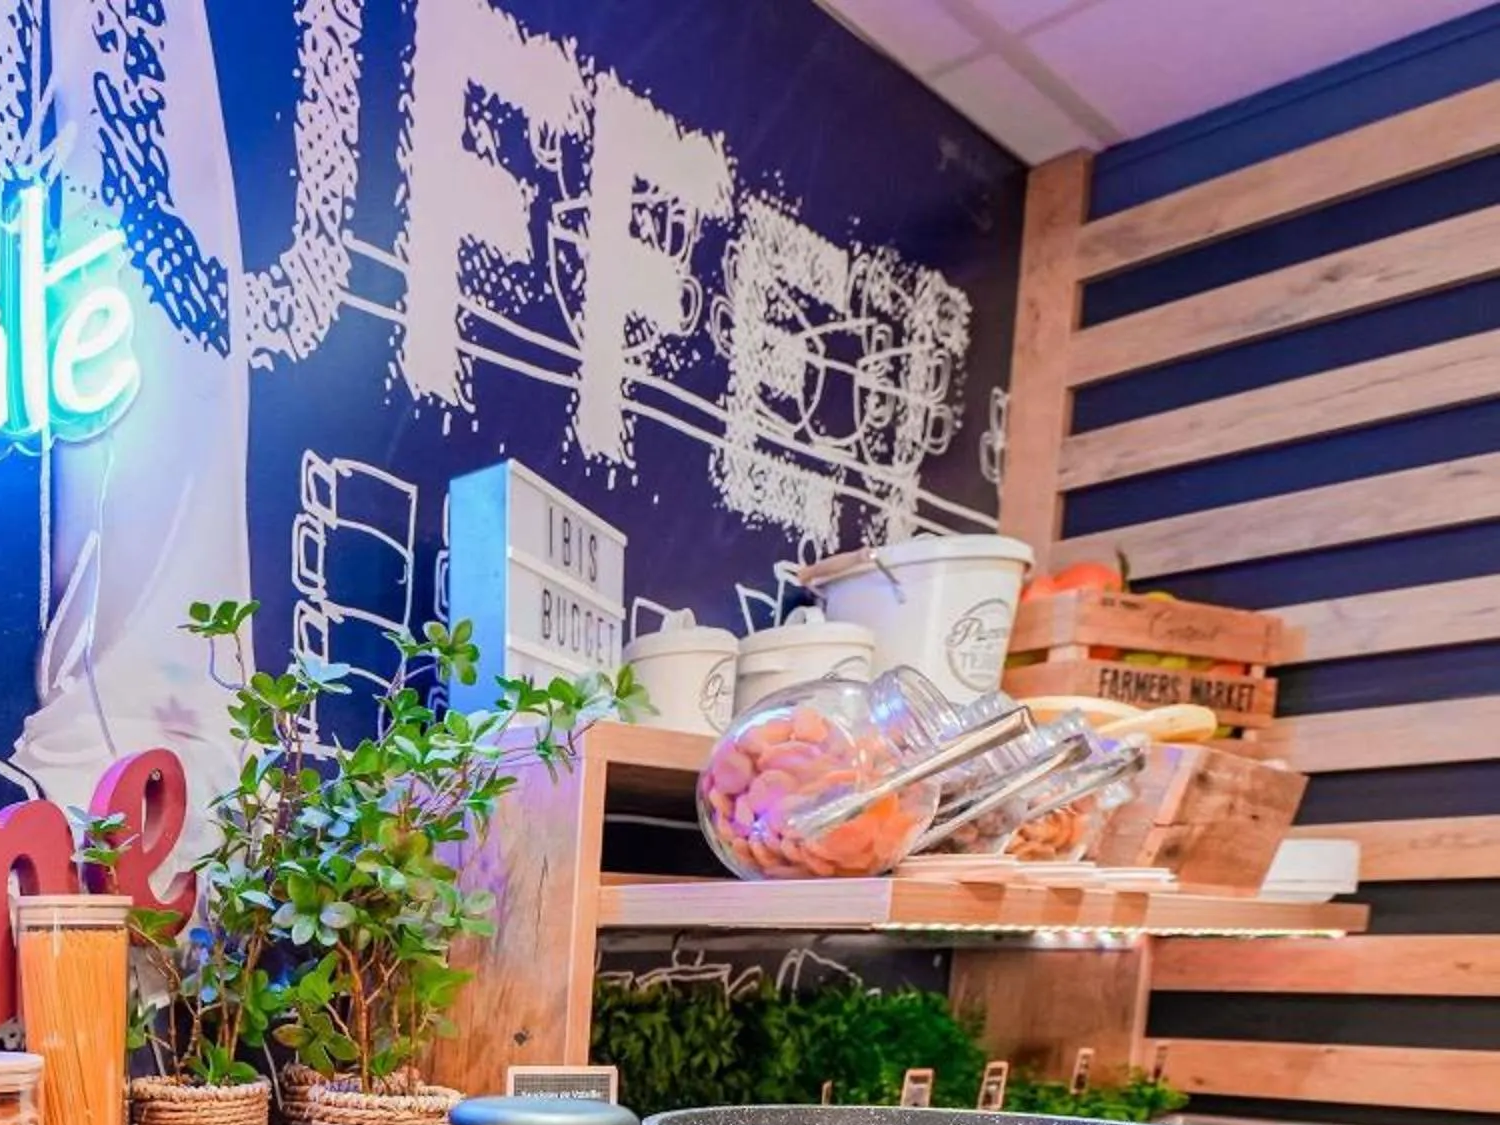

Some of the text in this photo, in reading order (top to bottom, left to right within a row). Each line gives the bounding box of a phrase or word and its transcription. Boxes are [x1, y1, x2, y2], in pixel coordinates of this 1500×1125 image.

[549, 506, 598, 583] IBIS
[542, 587, 615, 669] BUDGET
[1099, 667, 1256, 712] FARMERS MARKET
